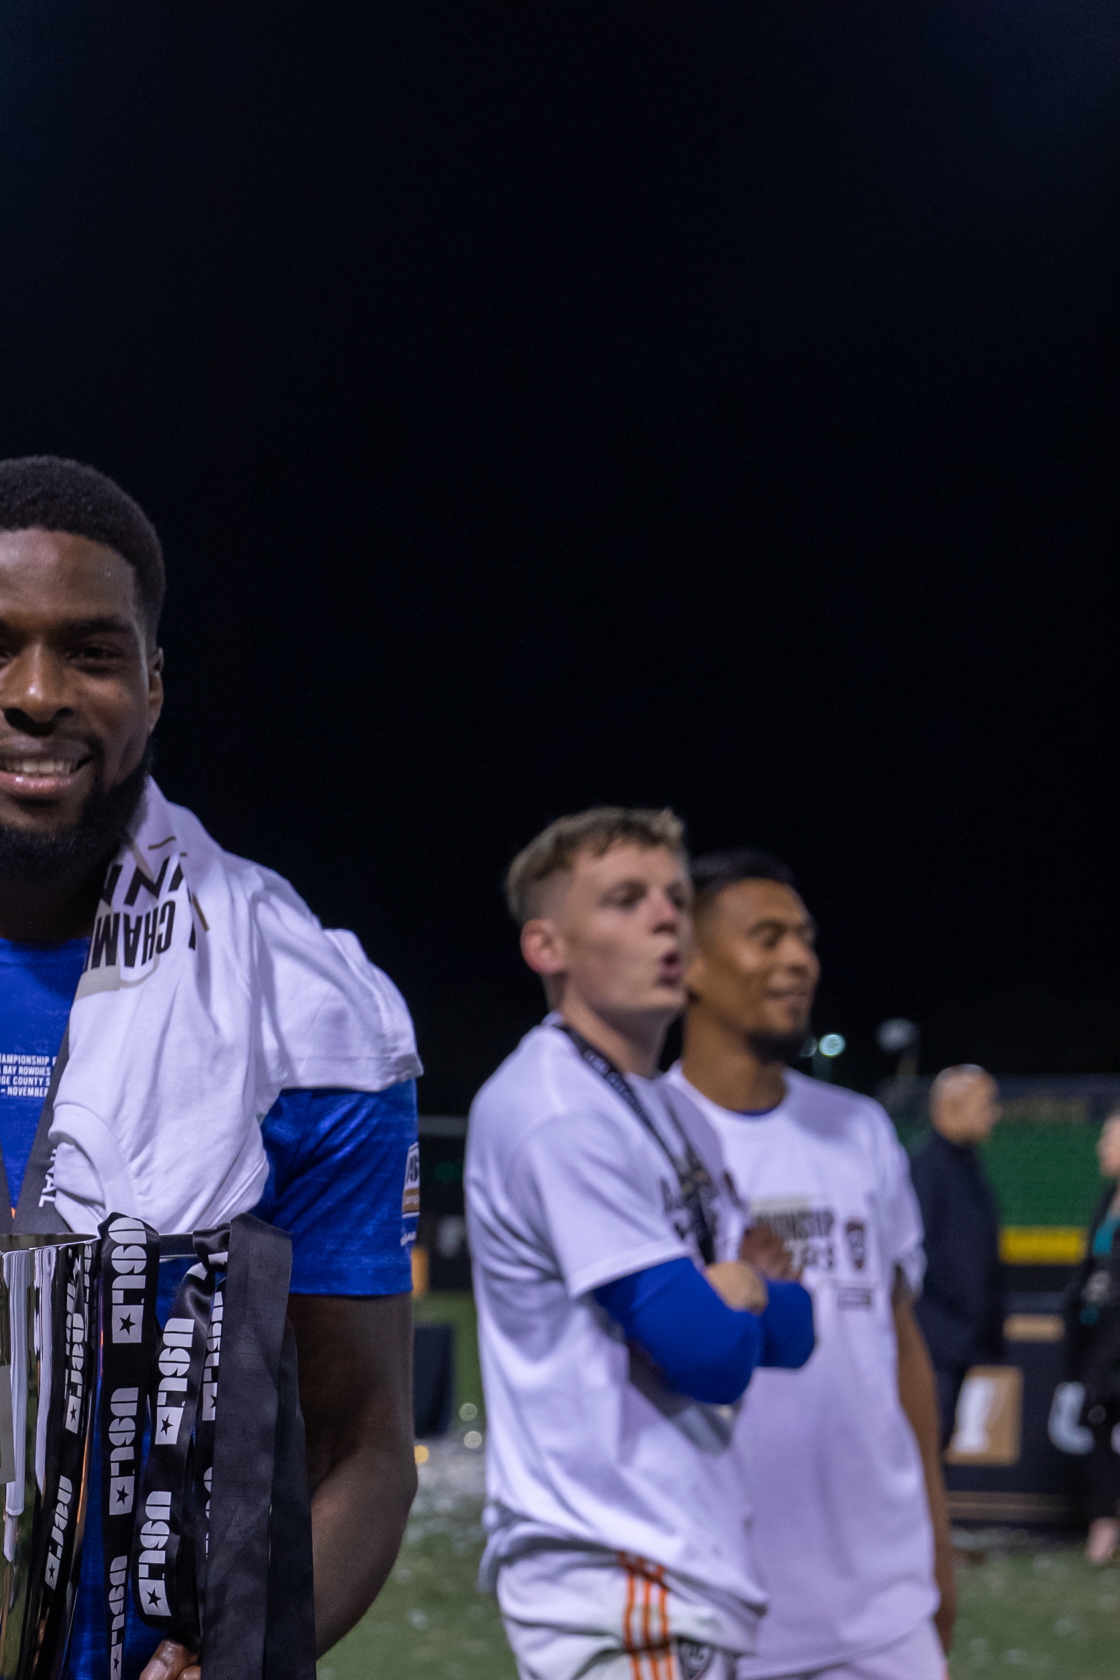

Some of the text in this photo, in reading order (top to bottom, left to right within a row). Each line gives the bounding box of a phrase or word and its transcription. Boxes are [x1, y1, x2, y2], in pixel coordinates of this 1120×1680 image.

[88, 900, 176, 972] CHAM
[3, 1065, 17, 1075] BAY
[18, 1065, 52, 1077] ROWDIES
[12, 1076, 44, 1087] COUNTY
